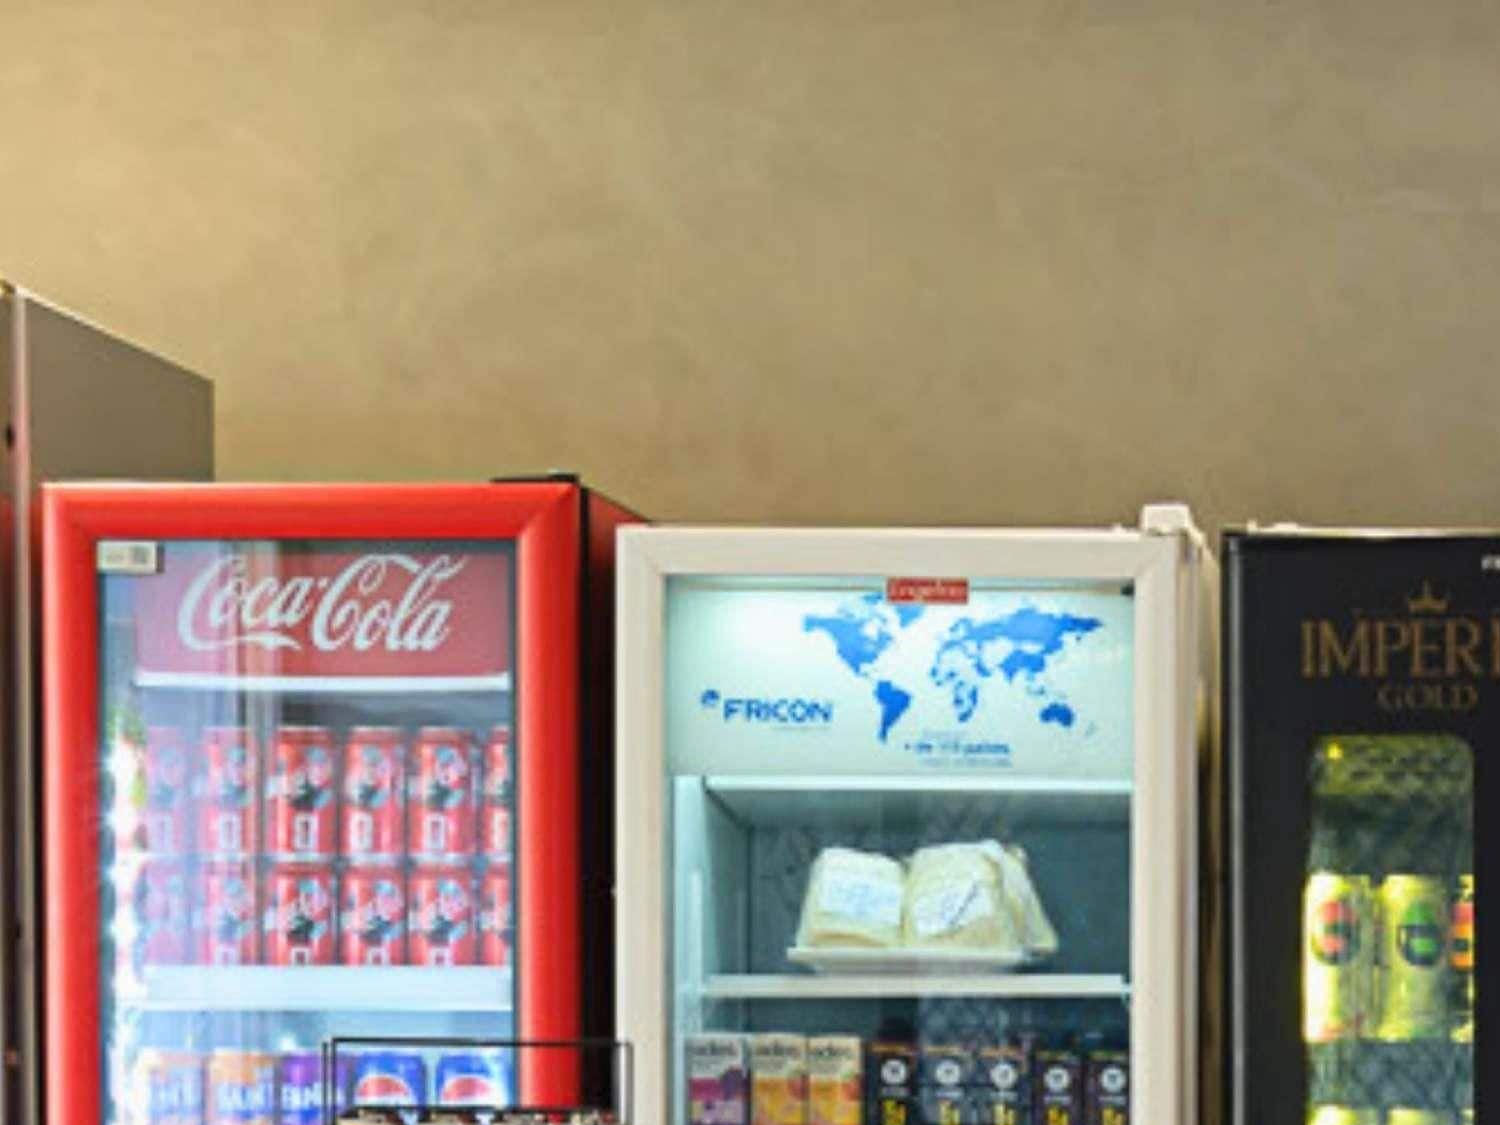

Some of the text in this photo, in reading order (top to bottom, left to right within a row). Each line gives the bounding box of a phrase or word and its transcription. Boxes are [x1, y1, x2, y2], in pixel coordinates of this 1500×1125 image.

[177, 553, 465, 652] Coca-Cola
[1376, 683, 1479, 710] GOLD
[723, 698, 833, 724] FRICON
